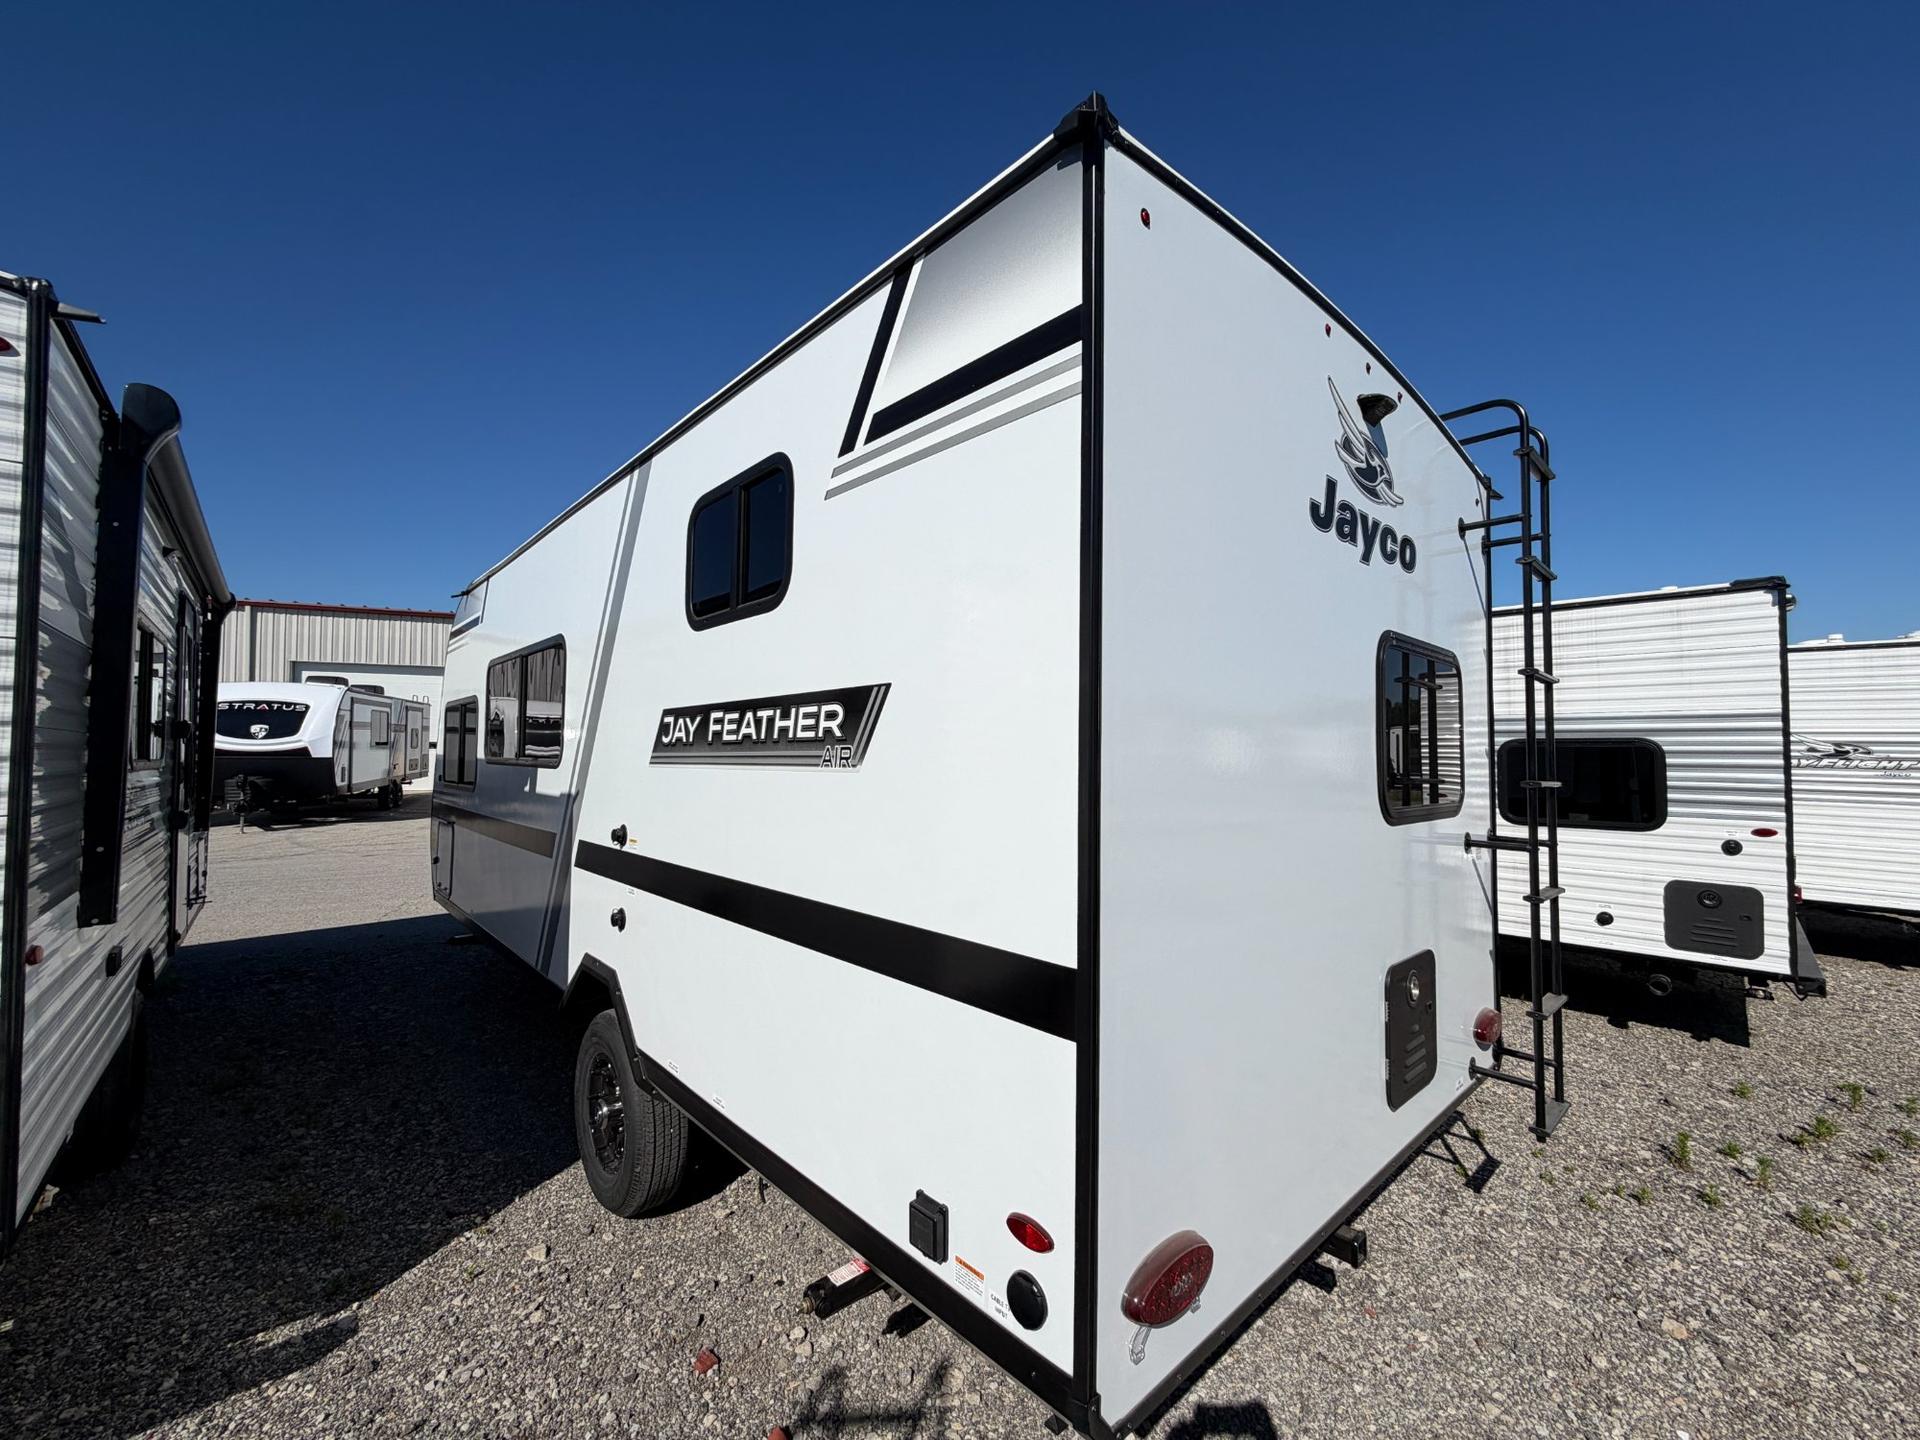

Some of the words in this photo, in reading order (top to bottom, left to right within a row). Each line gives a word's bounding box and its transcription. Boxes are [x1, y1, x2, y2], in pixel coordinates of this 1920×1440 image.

[1308, 473, 1417, 574] Jayco
[217, 702, 307, 711] STRATUS
[661, 714, 702, 744] JAY
[707, 702, 846, 743] FEATHER
[820, 744, 854, 768] AIR
